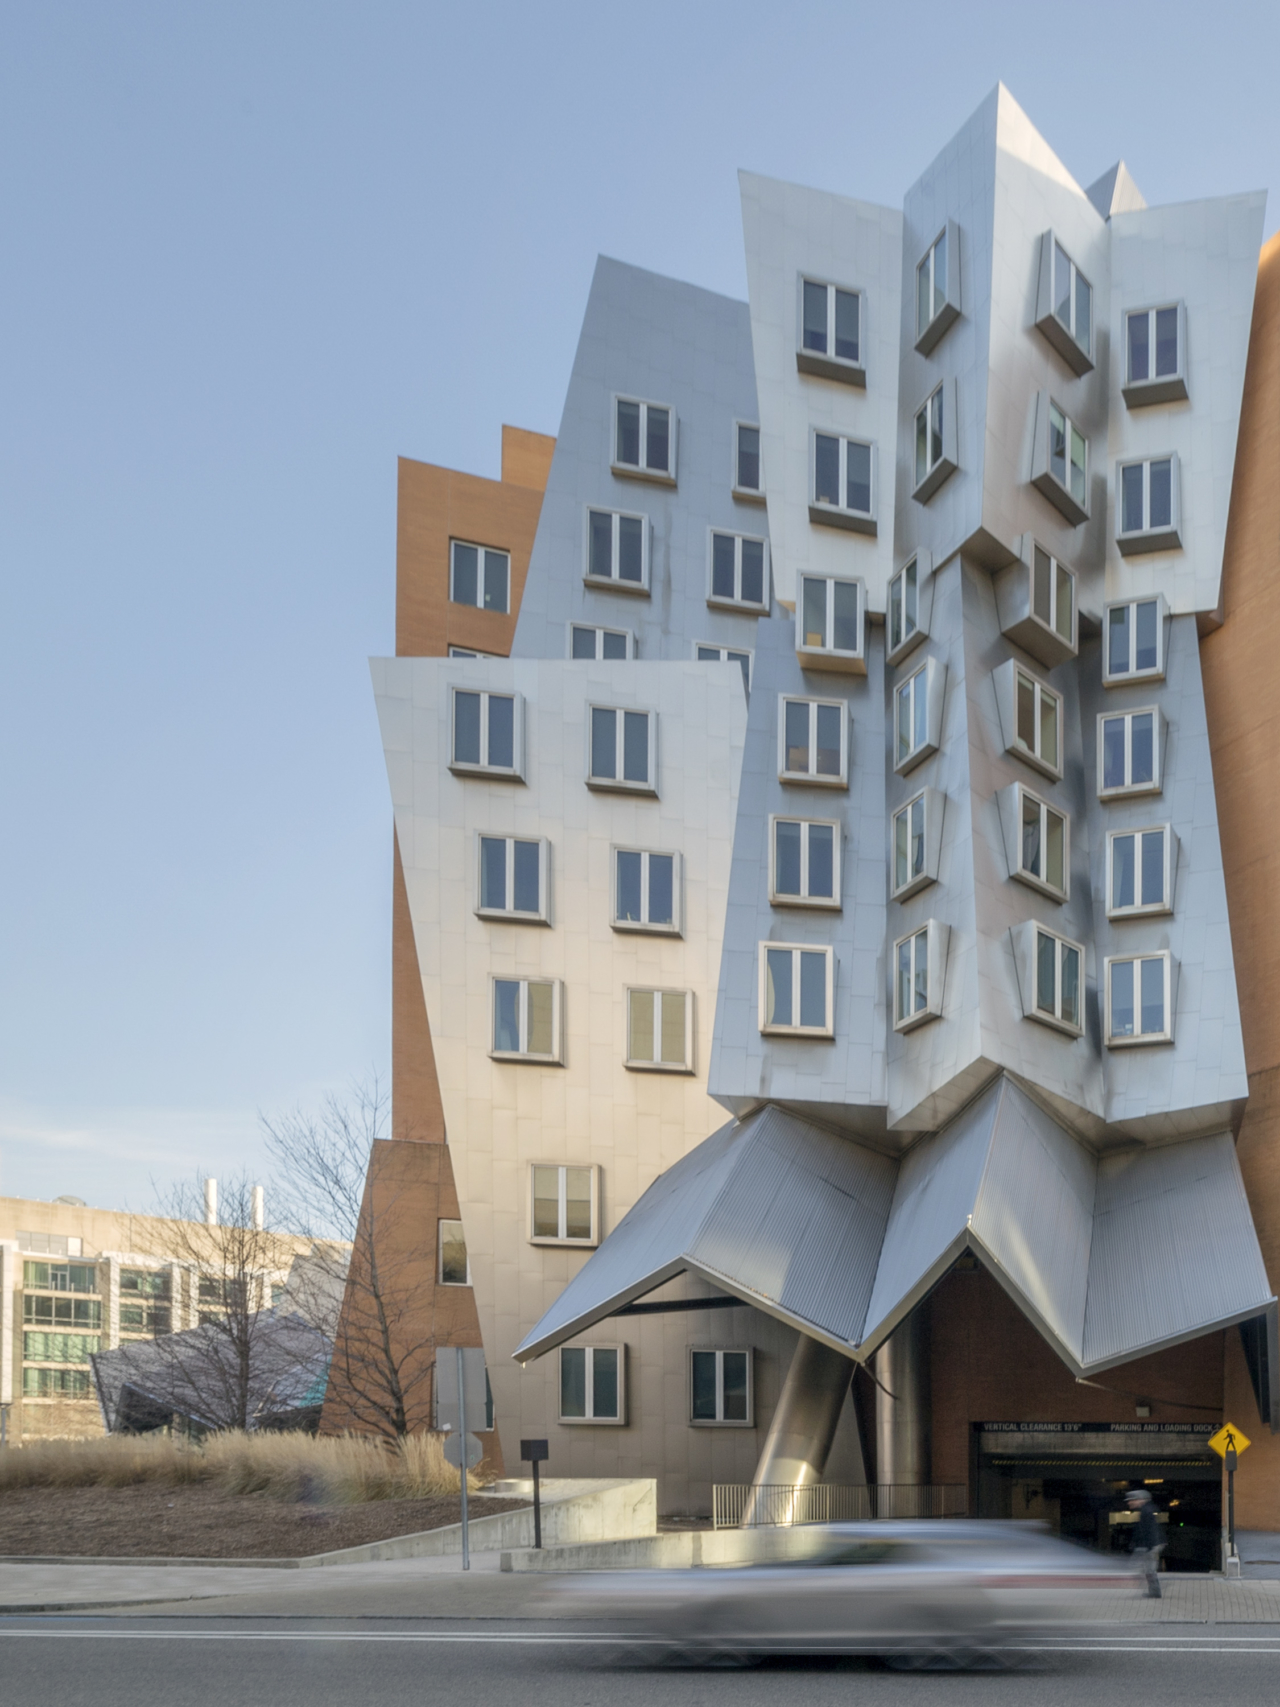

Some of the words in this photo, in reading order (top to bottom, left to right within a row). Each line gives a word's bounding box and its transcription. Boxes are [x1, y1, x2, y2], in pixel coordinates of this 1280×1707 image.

[984, 1423, 1018, 1431] VERTICAL
[1020, 1423, 1061, 1431] CLEARANCE
[1111, 1423, 1141, 1432] PARKING
[1143, 1424, 1159, 1432] AND
[1161, 1424, 1191, 1432] LOADING
[1193, 1424, 1213, 1432] DOCK
